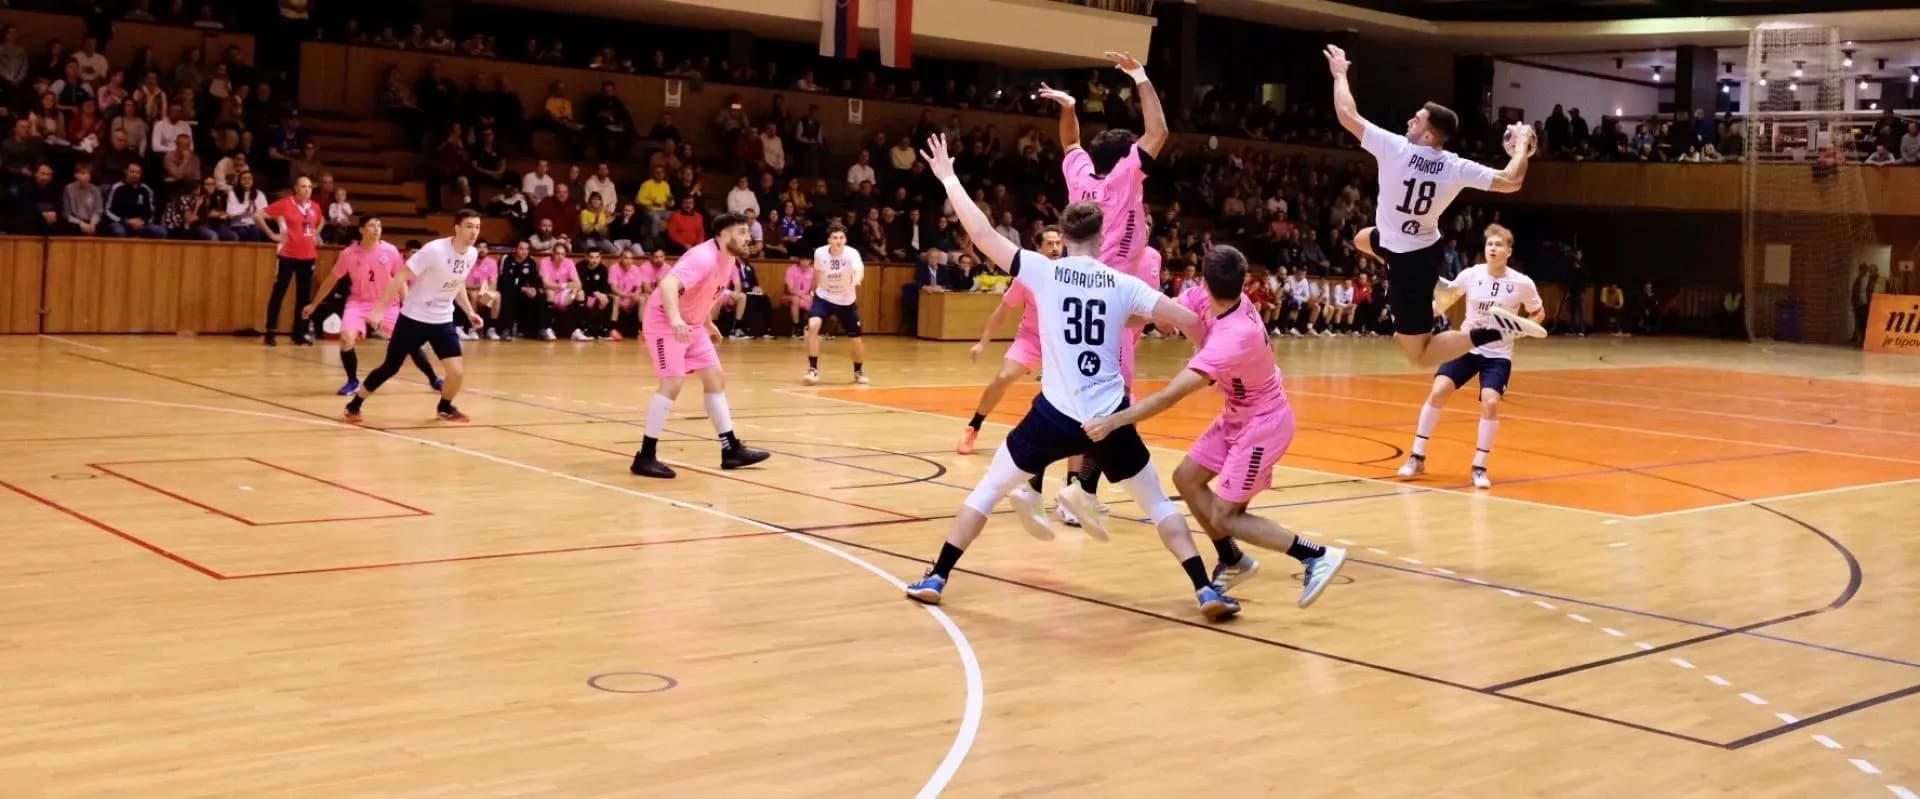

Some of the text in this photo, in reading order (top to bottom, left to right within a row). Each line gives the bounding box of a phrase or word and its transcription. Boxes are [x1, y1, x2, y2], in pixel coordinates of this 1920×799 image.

[1408, 154, 1444, 175] PROKOP
[1396, 178, 1436, 215] 18
[452, 259, 465, 274] 23
[830, 260, 840, 270] 39
[368, 269, 375, 282] 2
[1491, 282, 1500, 297] 9
[1063, 297, 1107, 346] 36
[1886, 304, 1920, 333] ni
